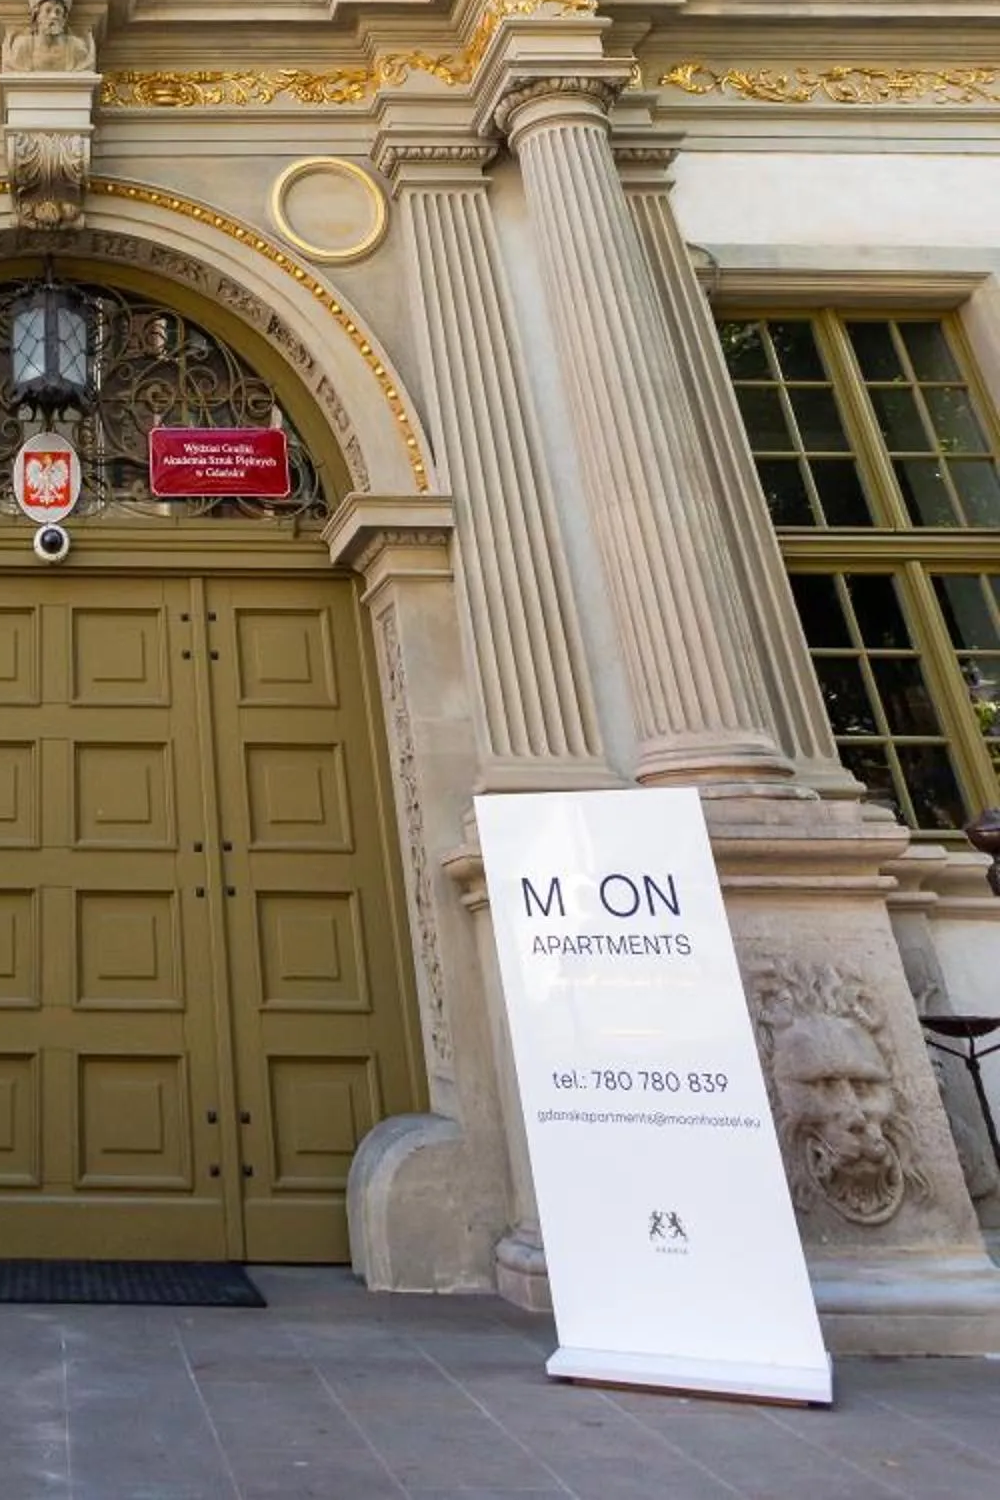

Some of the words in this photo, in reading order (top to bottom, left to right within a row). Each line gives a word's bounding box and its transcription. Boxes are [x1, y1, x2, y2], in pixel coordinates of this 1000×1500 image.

[521, 873, 680, 917] MON
[532, 934, 692, 956] APARTMENTS
[591, 1070, 633, 1091] 780
[638, 1071, 681, 1092] 780
[687, 1073, 729, 1093] 839
